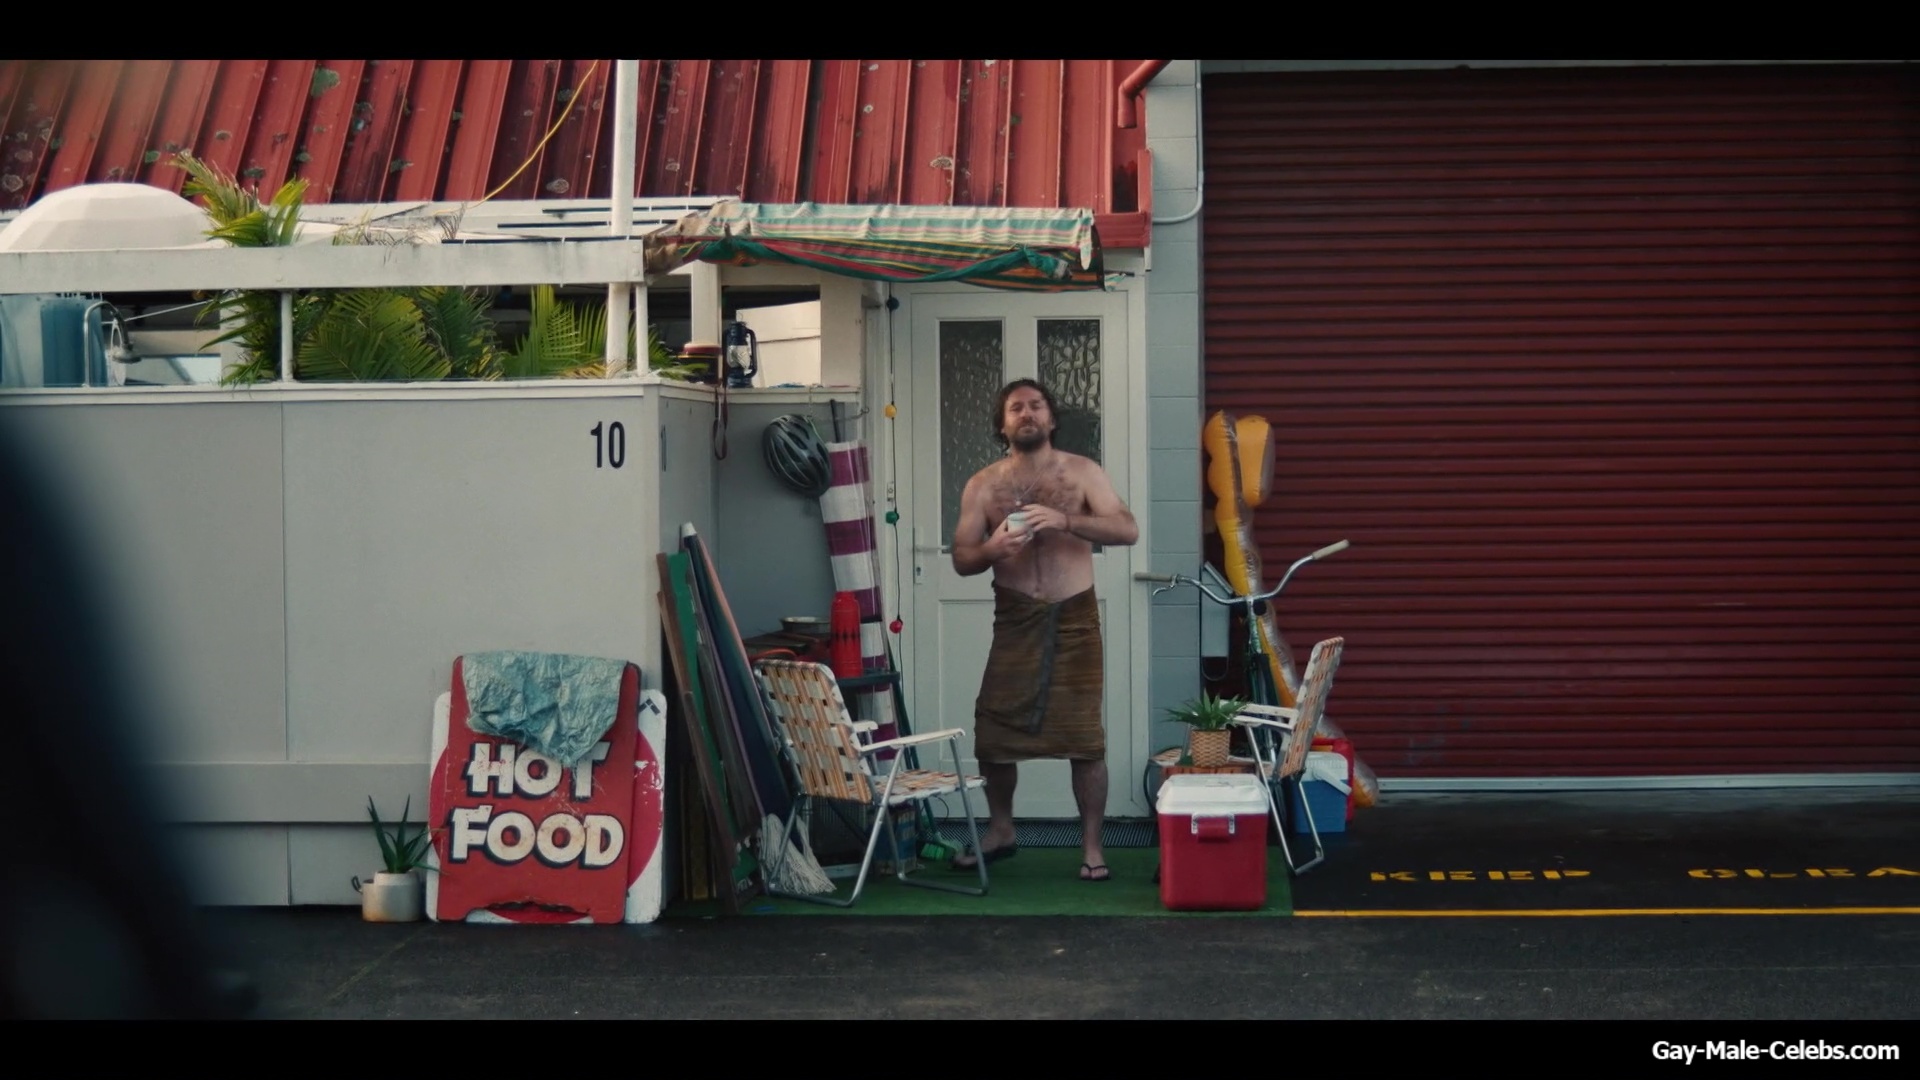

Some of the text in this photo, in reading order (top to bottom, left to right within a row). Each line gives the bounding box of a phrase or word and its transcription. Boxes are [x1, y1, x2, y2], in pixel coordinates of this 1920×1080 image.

[590, 421, 625, 468] 10
[464, 741, 611, 800] HOT
[449, 804, 625, 868] FOOD
[1370, 869, 1591, 881] KEEP
